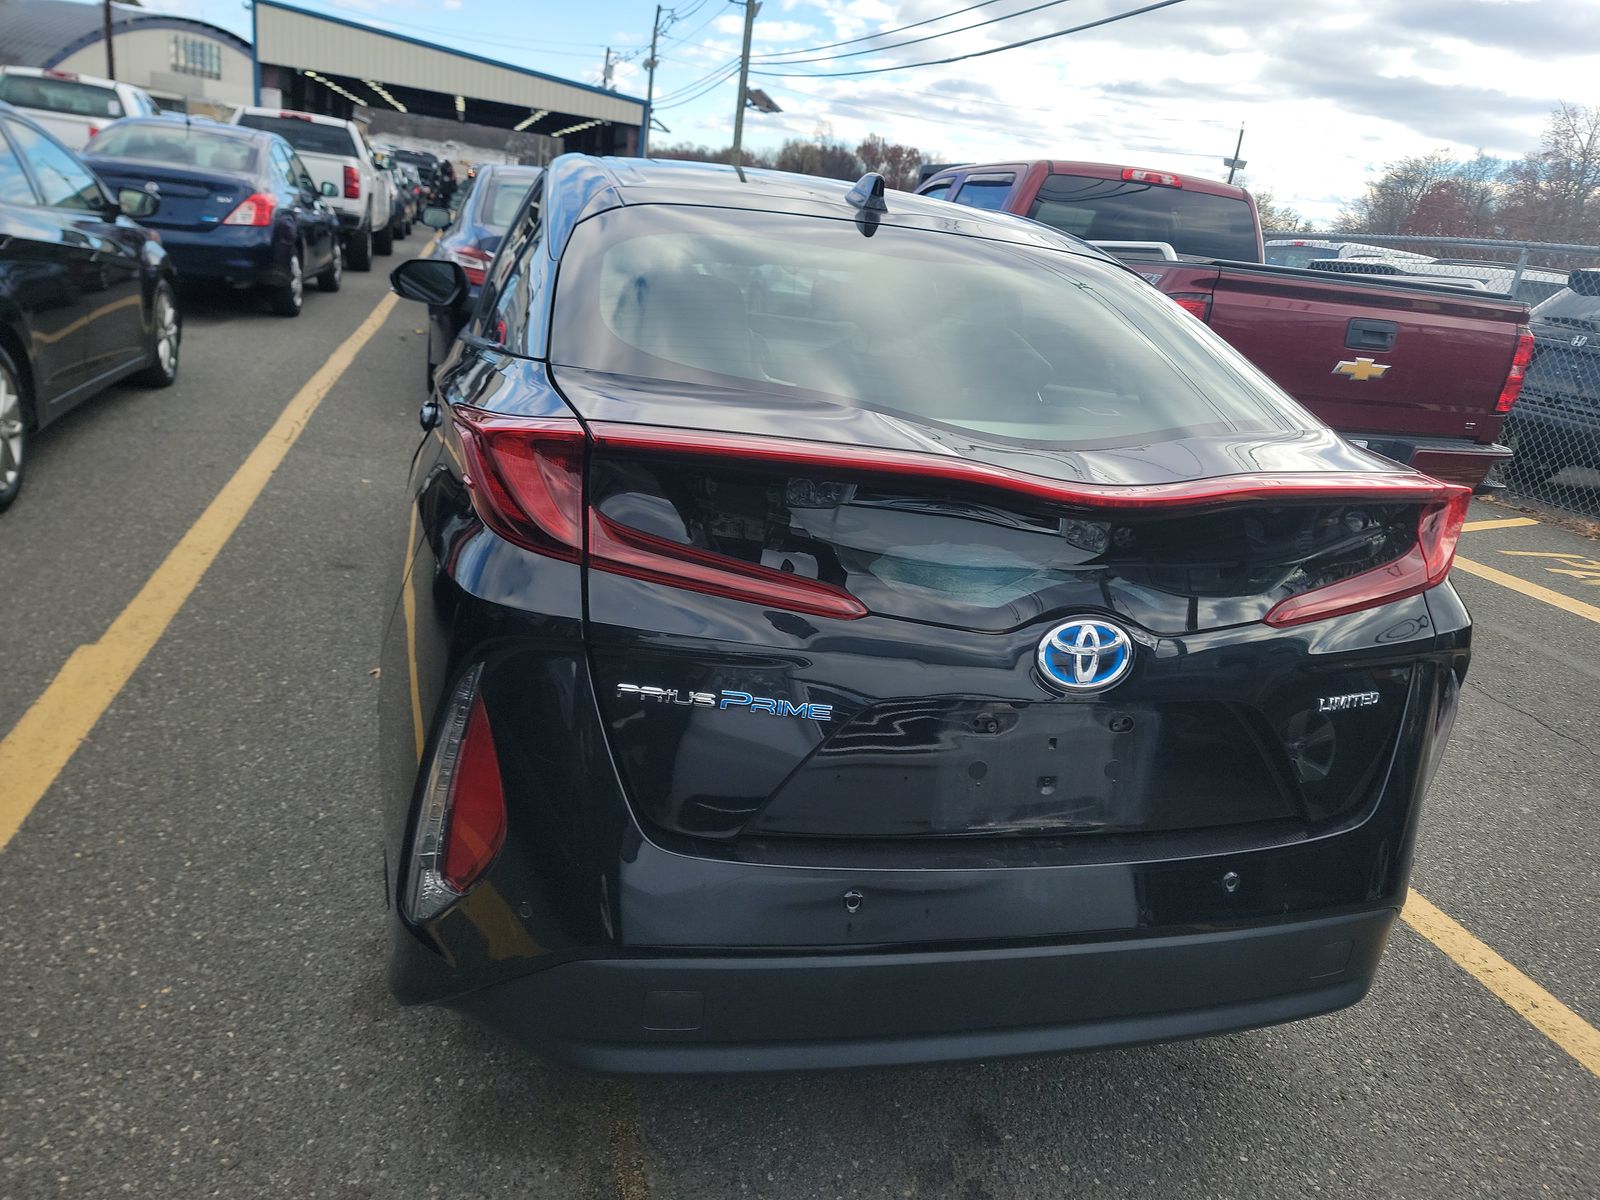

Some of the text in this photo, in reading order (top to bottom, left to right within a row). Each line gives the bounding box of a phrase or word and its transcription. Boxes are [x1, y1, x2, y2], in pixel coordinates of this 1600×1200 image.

[616, 683, 833, 722] PRIUS PRIME
[1318, 691, 1380, 712] LIMITED
